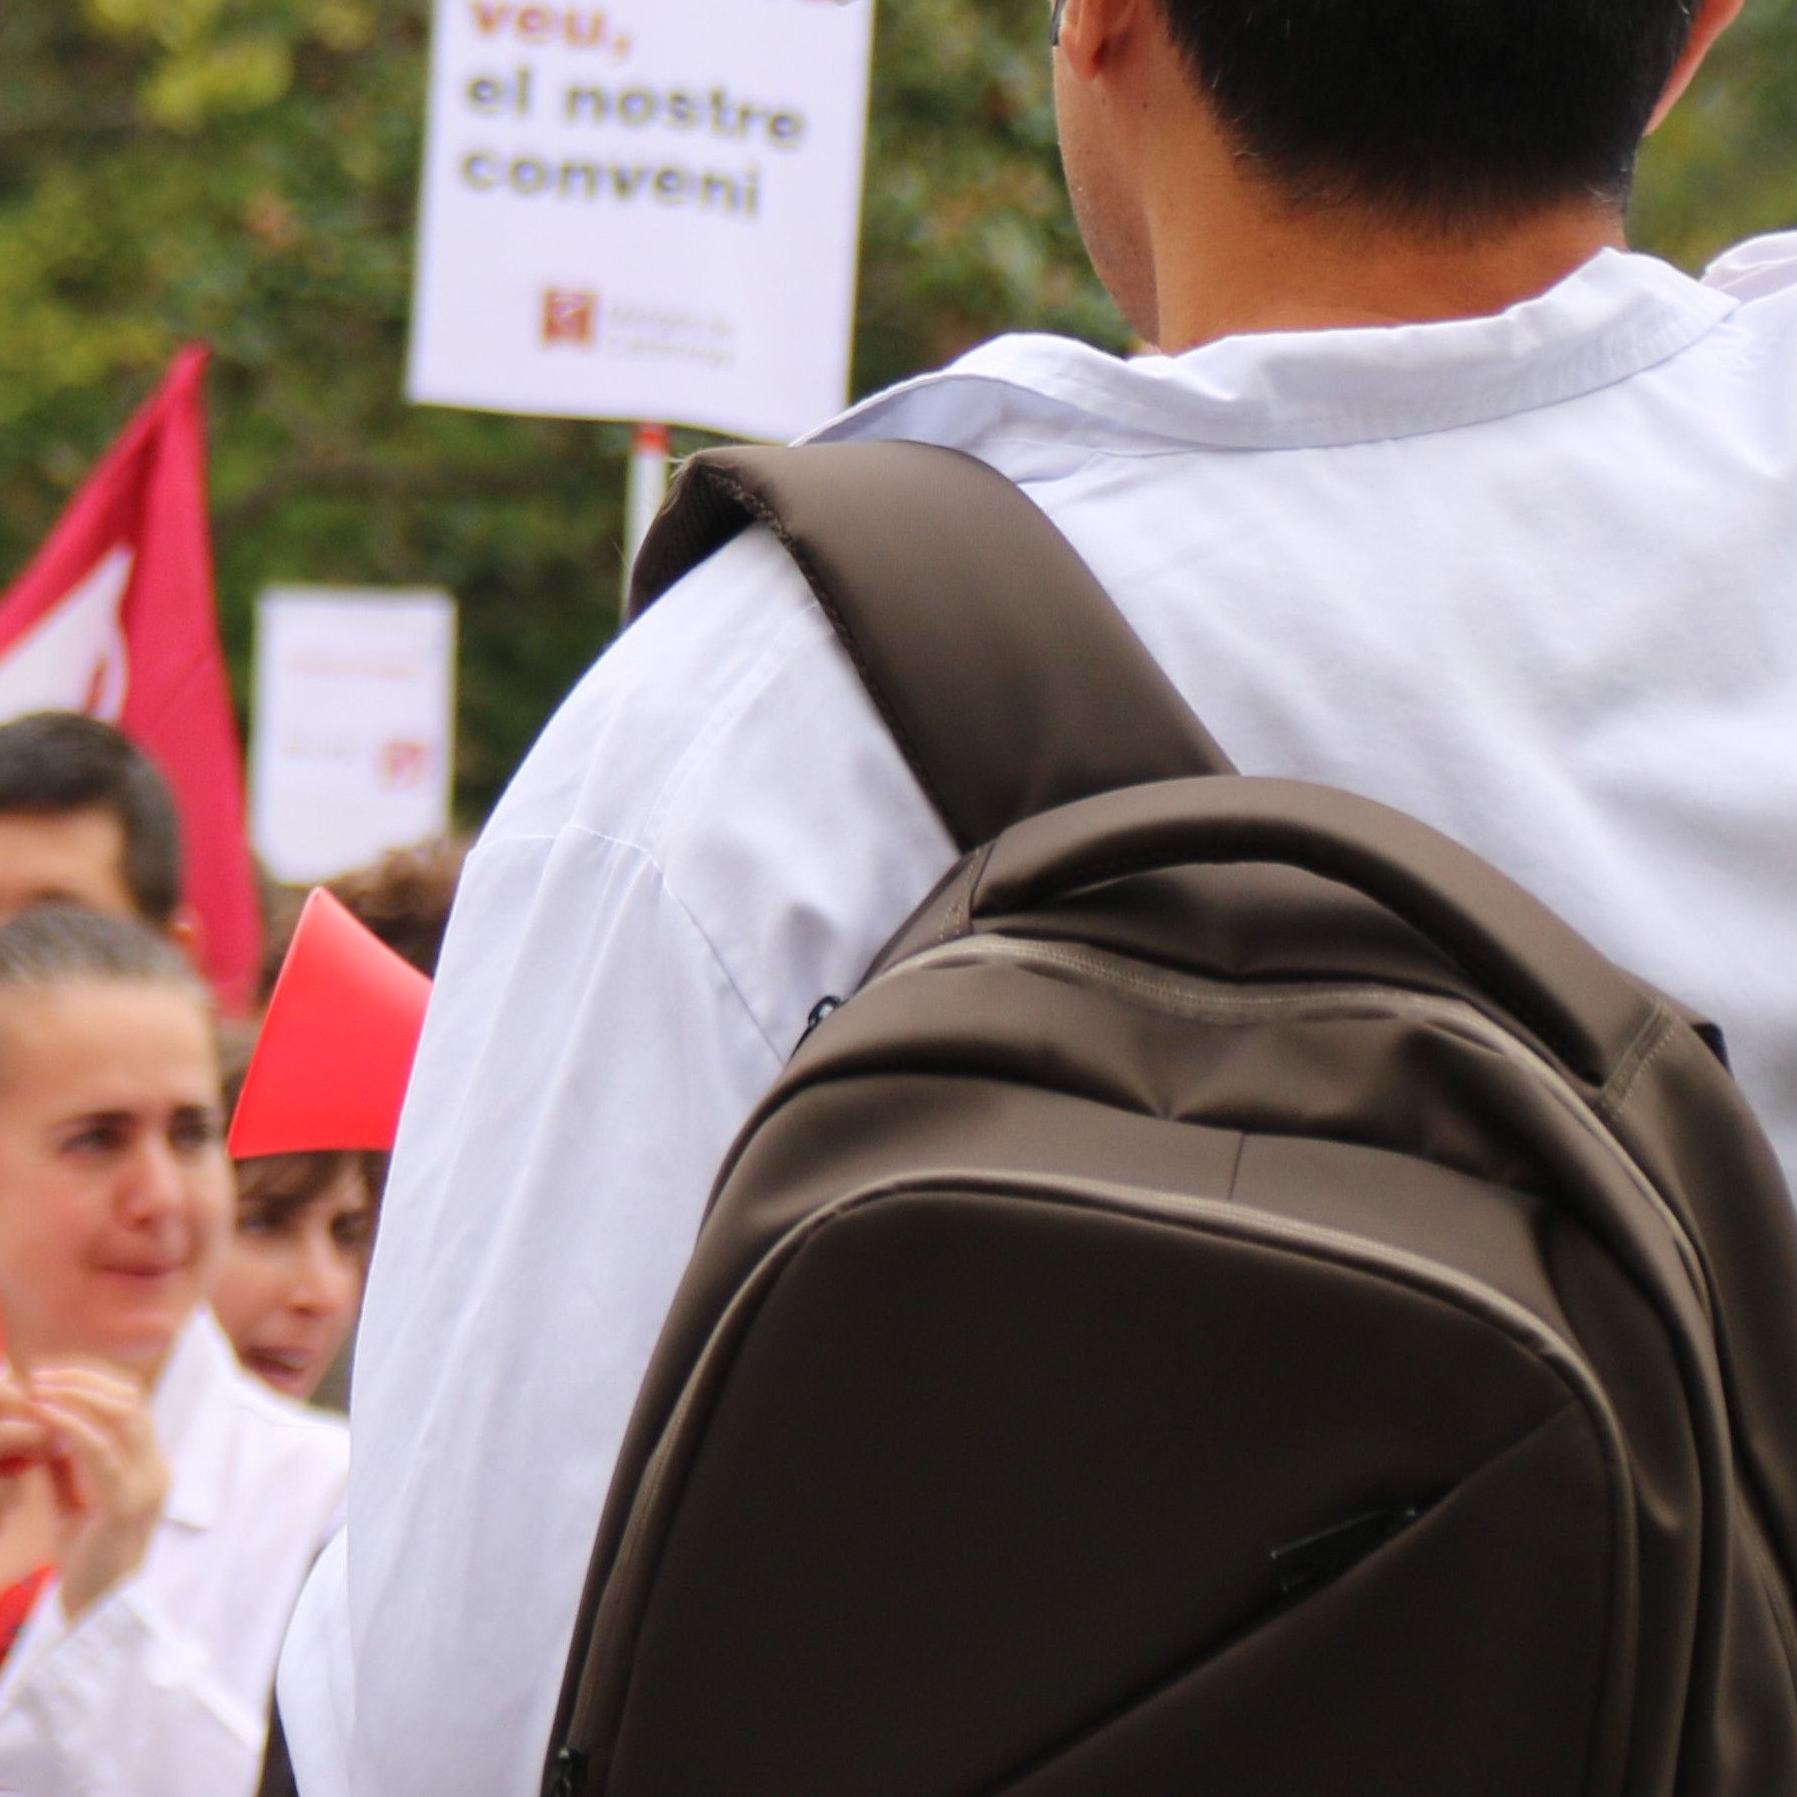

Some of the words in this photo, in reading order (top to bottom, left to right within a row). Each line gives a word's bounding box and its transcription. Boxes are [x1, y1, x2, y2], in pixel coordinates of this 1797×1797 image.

[463, 61, 532, 117] el
[562, 79, 807, 149] nostre
[459, 149, 761, 218] conveni
